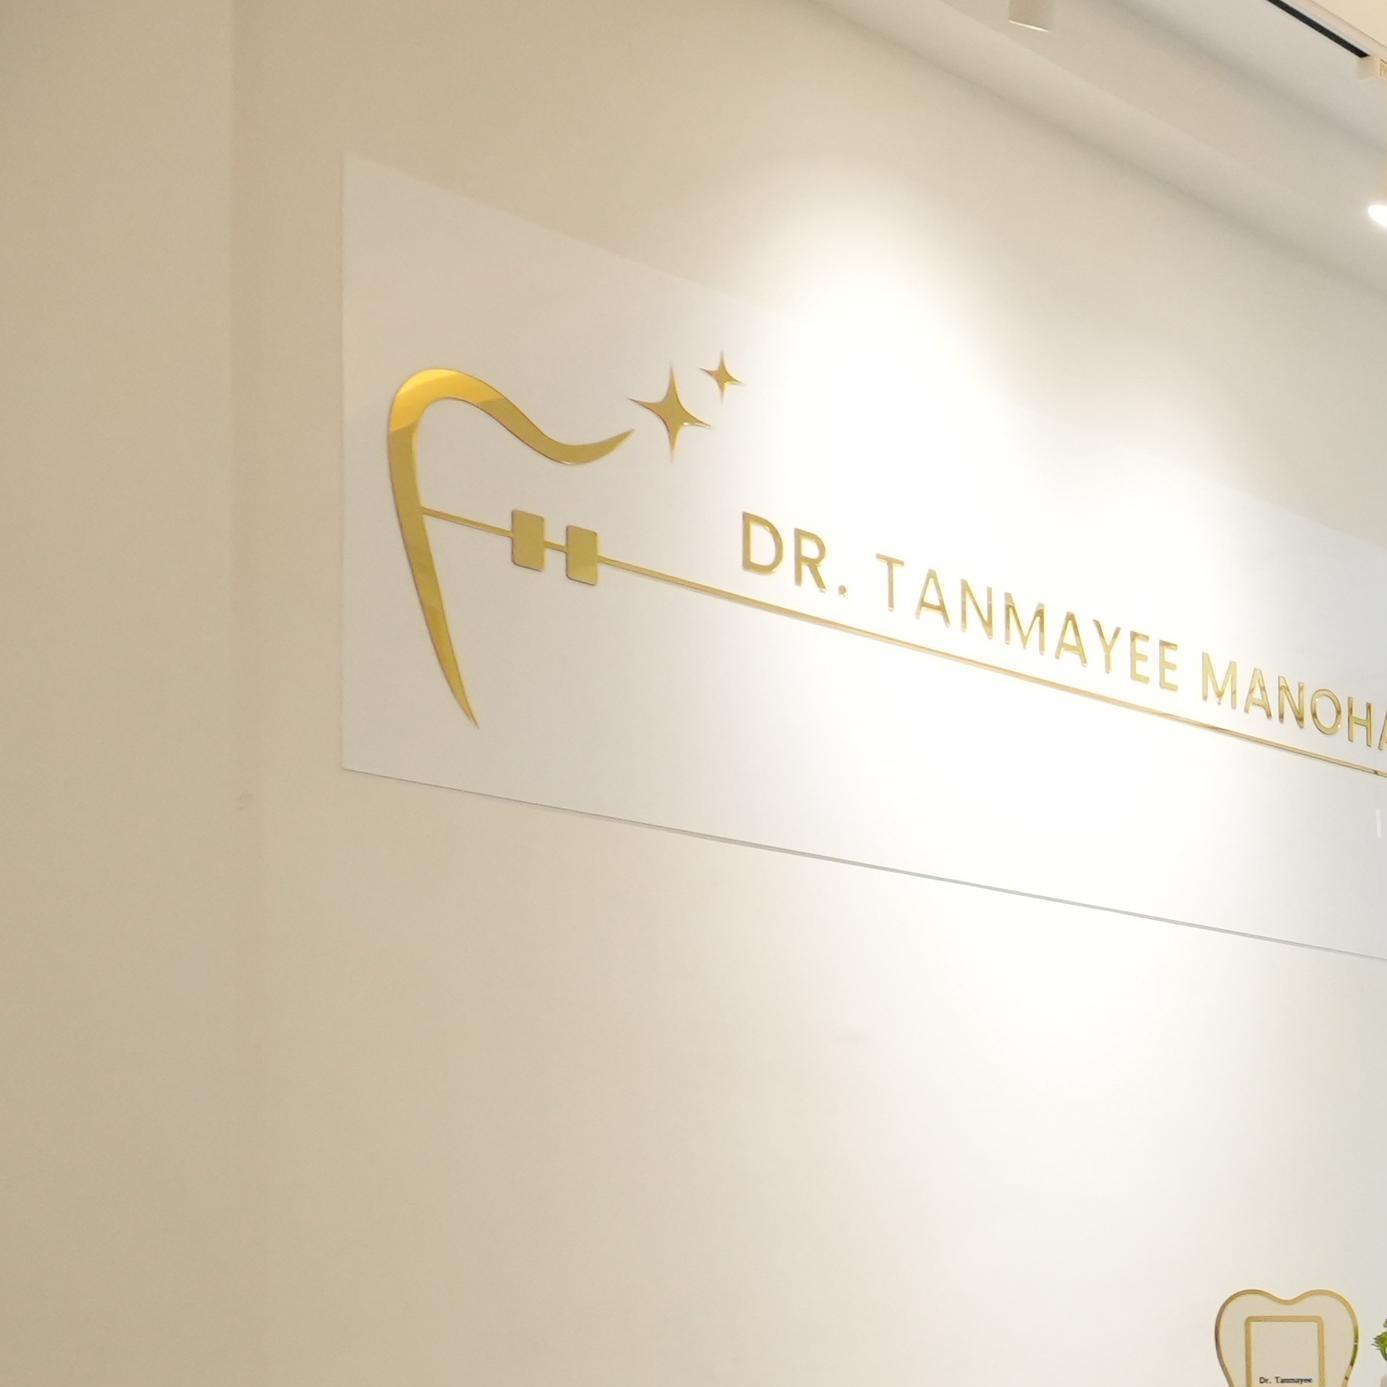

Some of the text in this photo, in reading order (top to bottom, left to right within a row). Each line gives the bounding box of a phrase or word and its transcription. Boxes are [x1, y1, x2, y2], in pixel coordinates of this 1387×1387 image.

[741, 511, 848, 597] DR.
[875, 553, 1179, 693] TANMAYEE
[1258, 1376, 1314, 1385] Dr. Tanmayee
